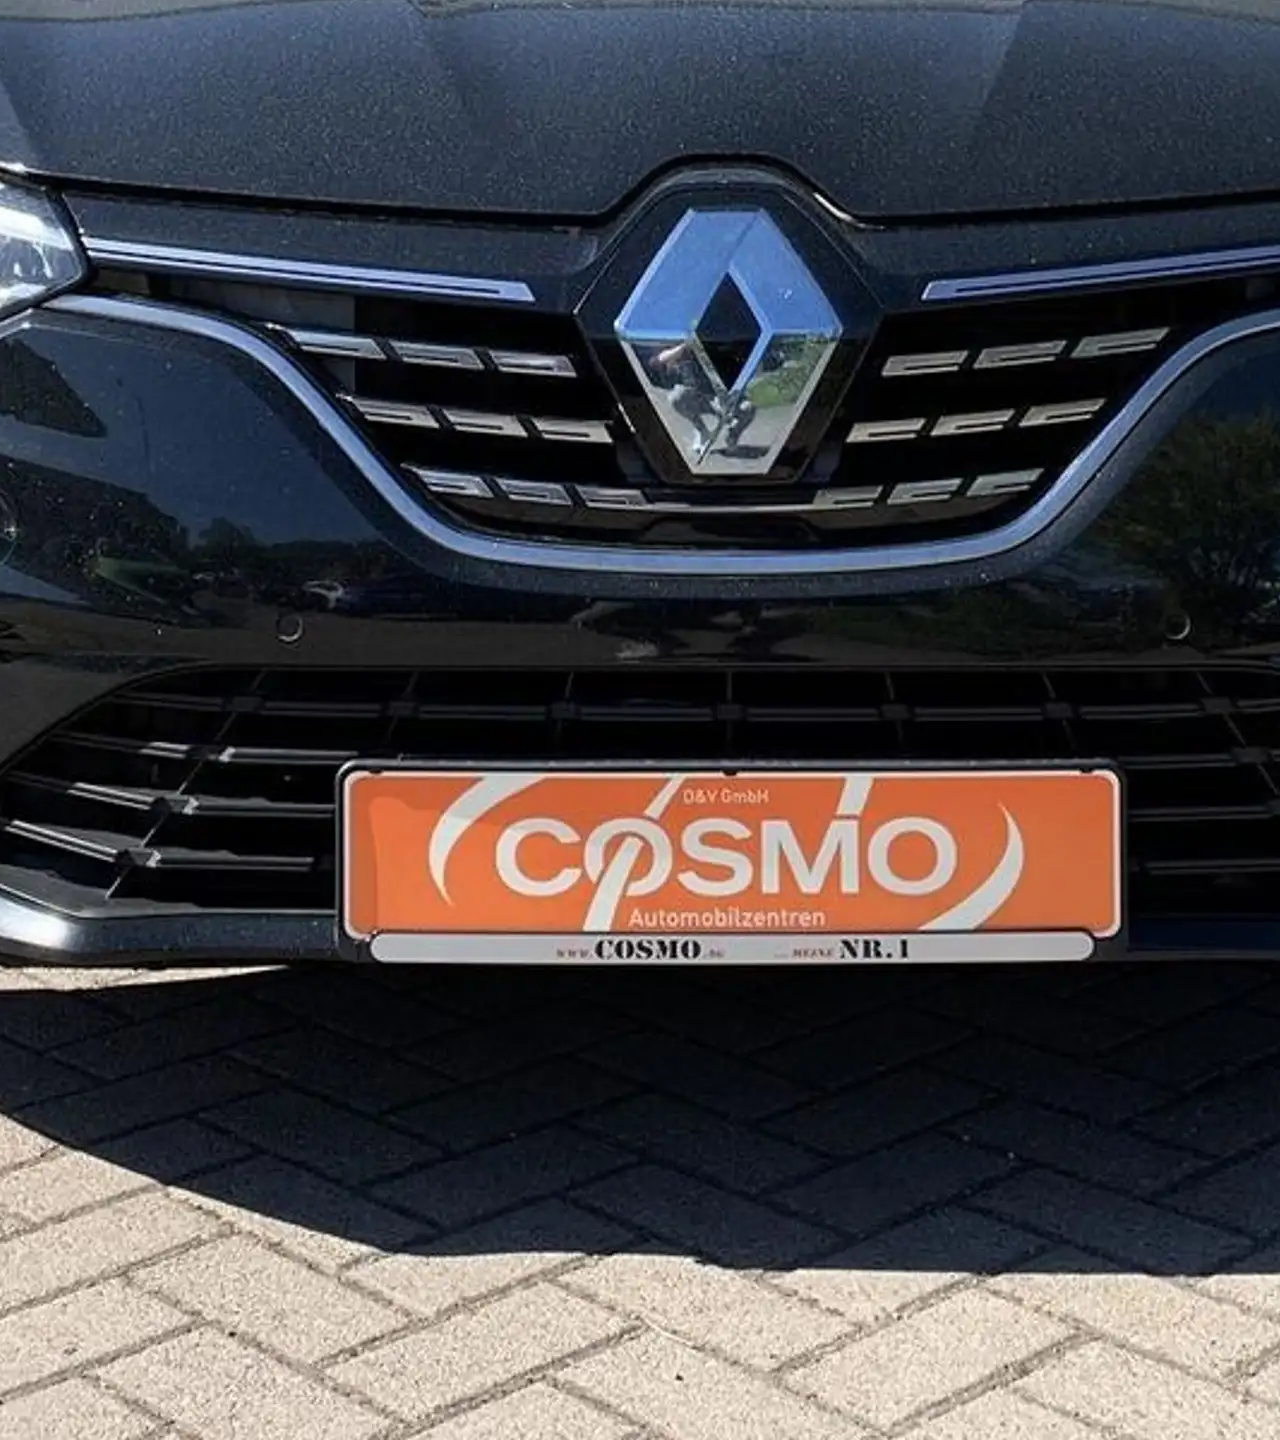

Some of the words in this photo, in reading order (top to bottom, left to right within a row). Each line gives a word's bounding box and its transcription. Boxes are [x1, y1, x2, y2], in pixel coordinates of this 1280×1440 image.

[720, 788, 771, 805] GmbH
[494, 816, 959, 898] COSMO
[628, 907, 826, 929] Automobilzentren
